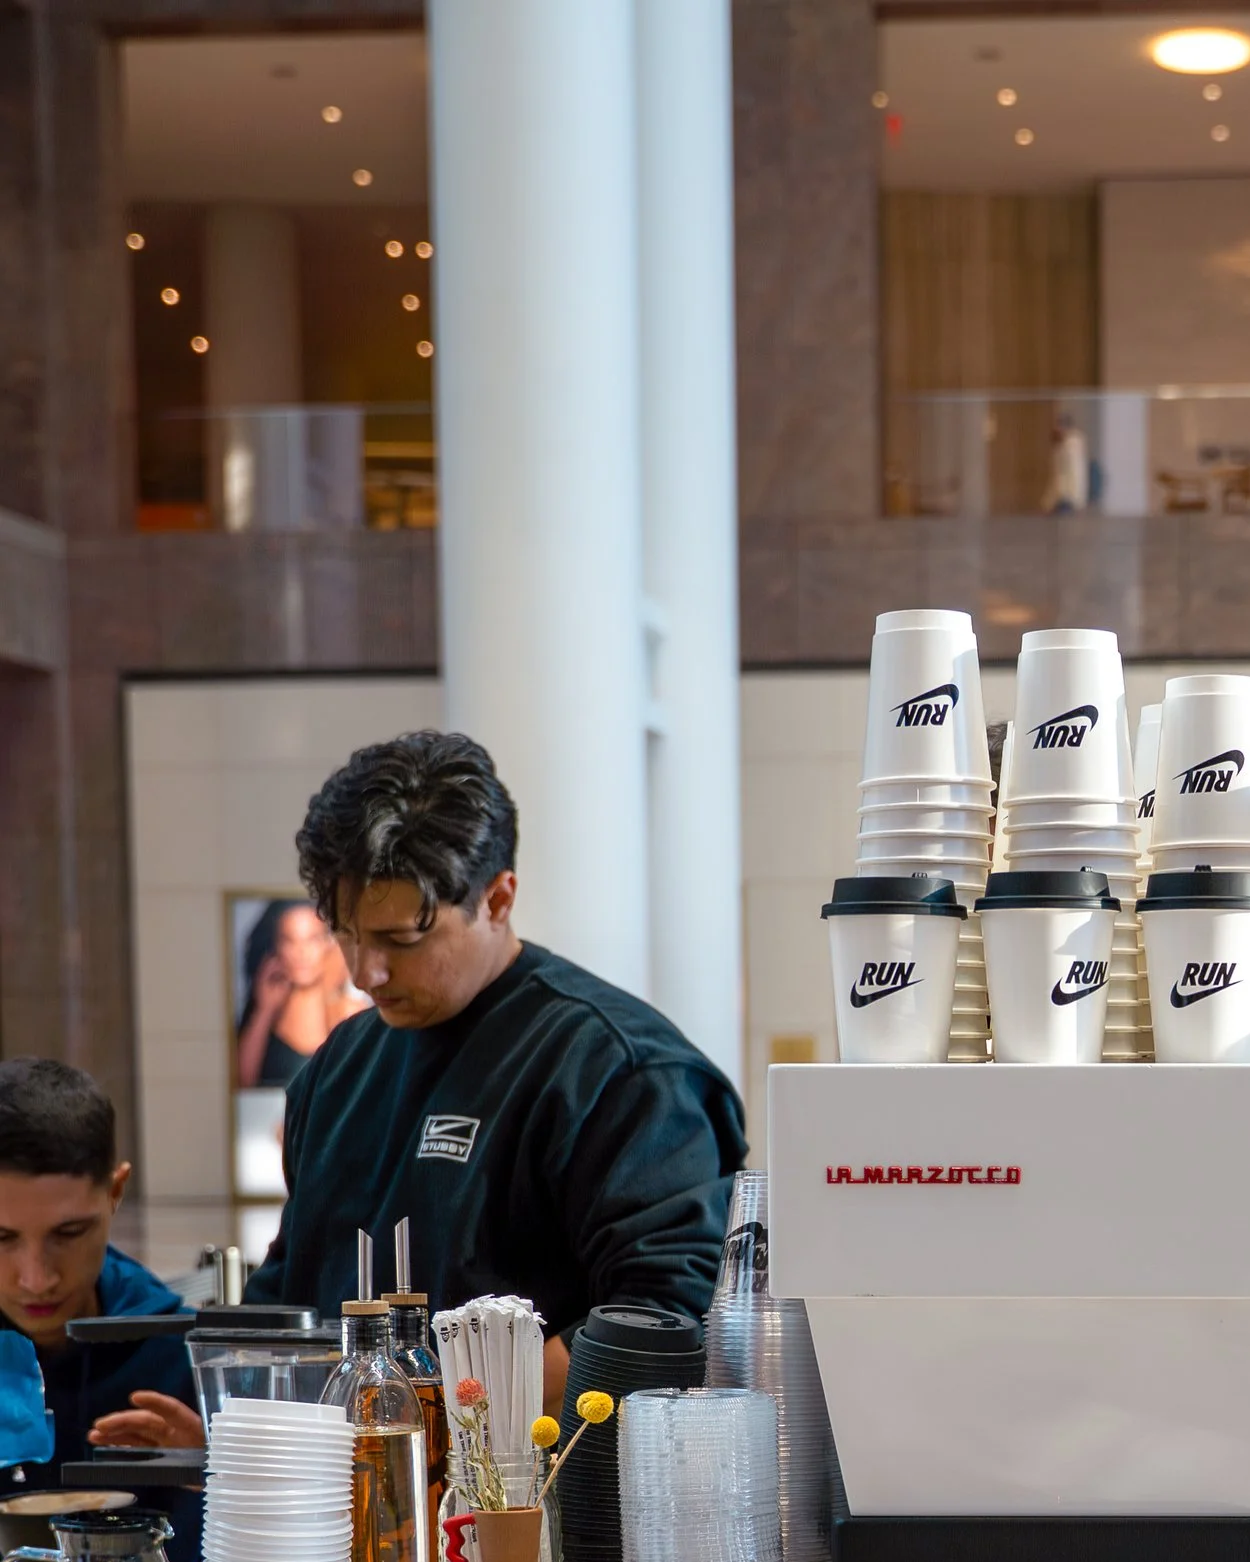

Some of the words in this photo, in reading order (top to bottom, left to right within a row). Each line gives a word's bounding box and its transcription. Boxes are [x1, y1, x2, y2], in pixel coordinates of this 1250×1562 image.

[896, 703, 948, 727] RUN
[1033, 725, 1085, 749] RUN
[1180, 770, 1233, 794] RUN
[860, 962, 916, 986] RUN
[1065, 961, 1109, 985] RUN
[1181, 963, 1236, 986] RUN
[827, 1166, 851, 1184] LA
